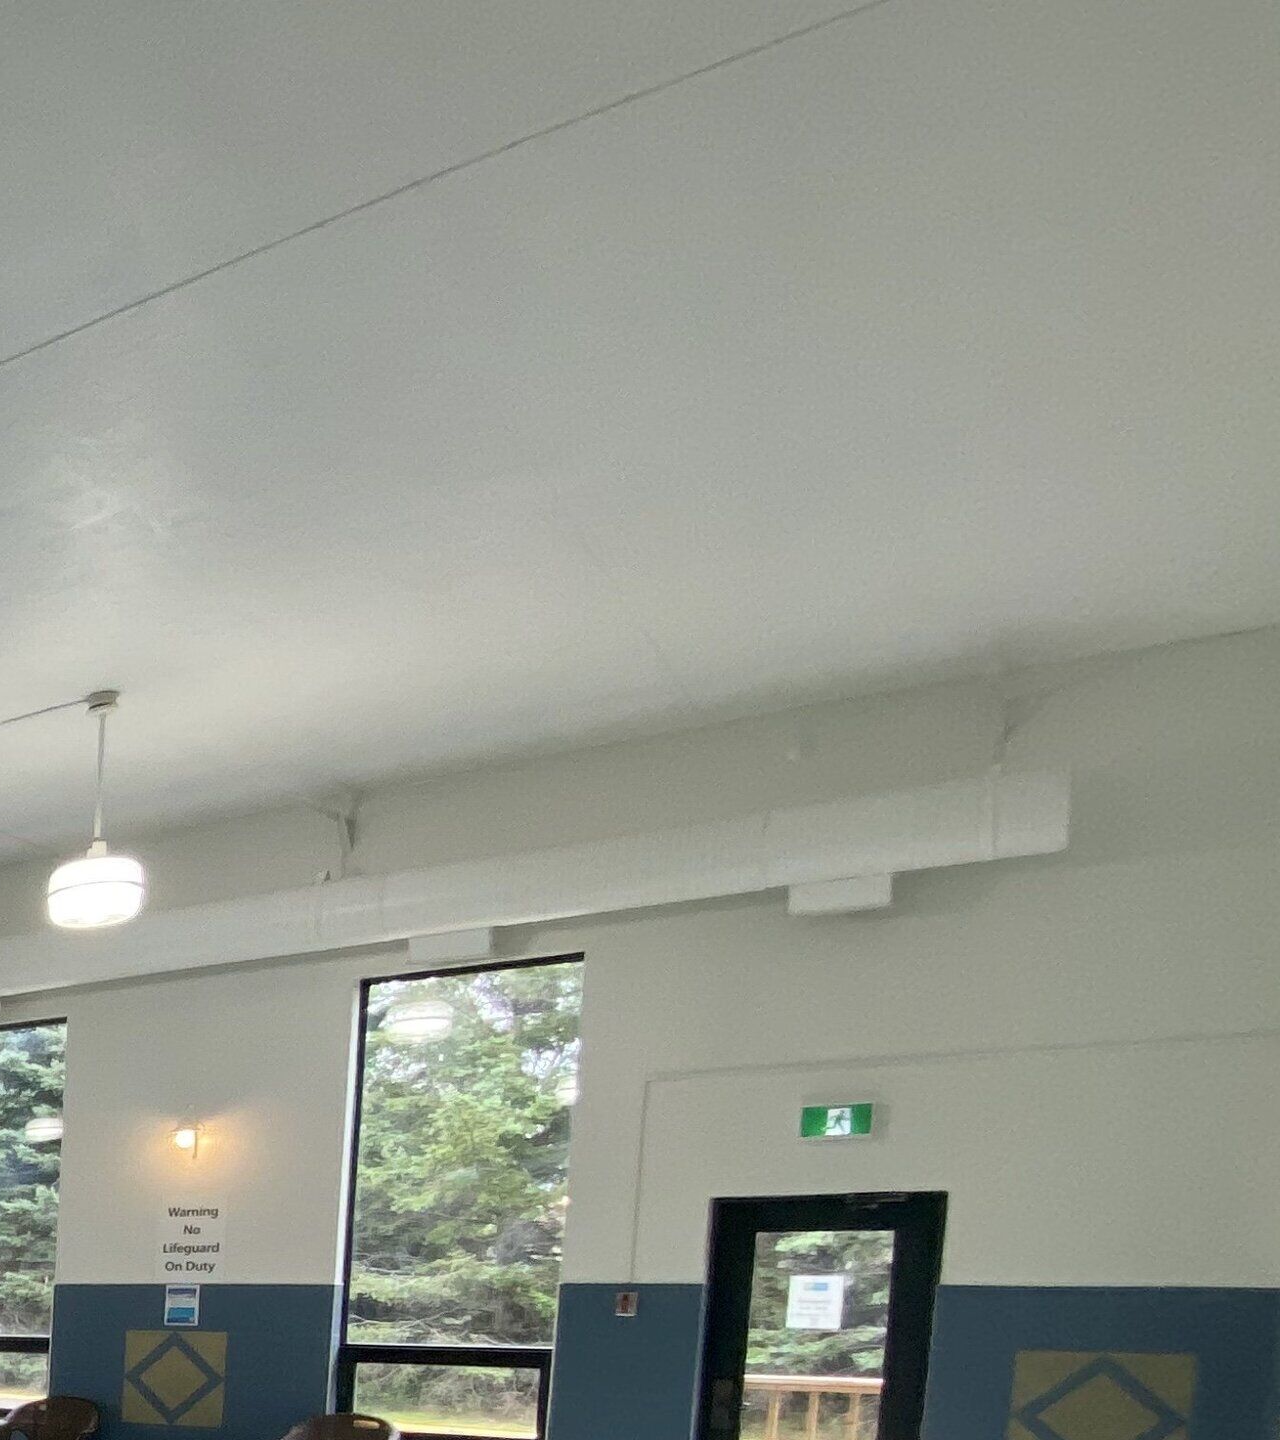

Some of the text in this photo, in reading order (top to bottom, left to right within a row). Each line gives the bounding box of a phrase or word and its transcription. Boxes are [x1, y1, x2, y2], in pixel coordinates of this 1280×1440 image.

[168, 1207, 219, 1219] Warning
[183, 1225, 201, 1234] No
[162, 1242, 220, 1256] Lifeguard
[164, 1261, 216, 1274] On Duty
